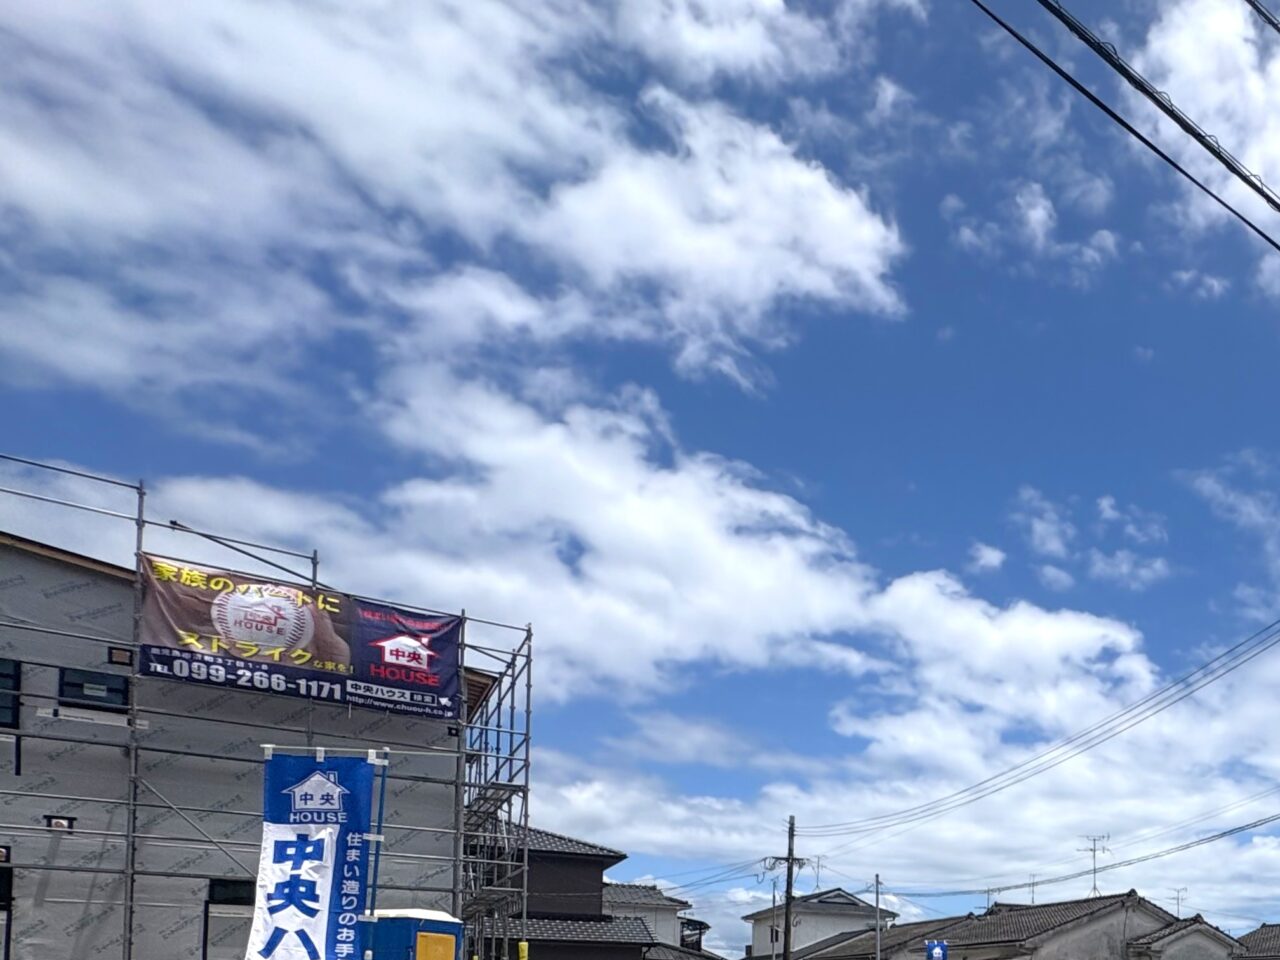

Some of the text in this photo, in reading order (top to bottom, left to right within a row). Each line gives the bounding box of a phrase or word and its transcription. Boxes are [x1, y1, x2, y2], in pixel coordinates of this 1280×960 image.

[233, 619, 285, 636] HOUSE
[390, 648, 423, 665] 中央
[173, 660, 341, 699] 099-266-1171
[369, 663, 440, 687] HOUSE
[350, 683, 408, 700] 中央ハウス
[300, 792, 336, 806] 中央
[289, 811, 348, 823] HOUSE
